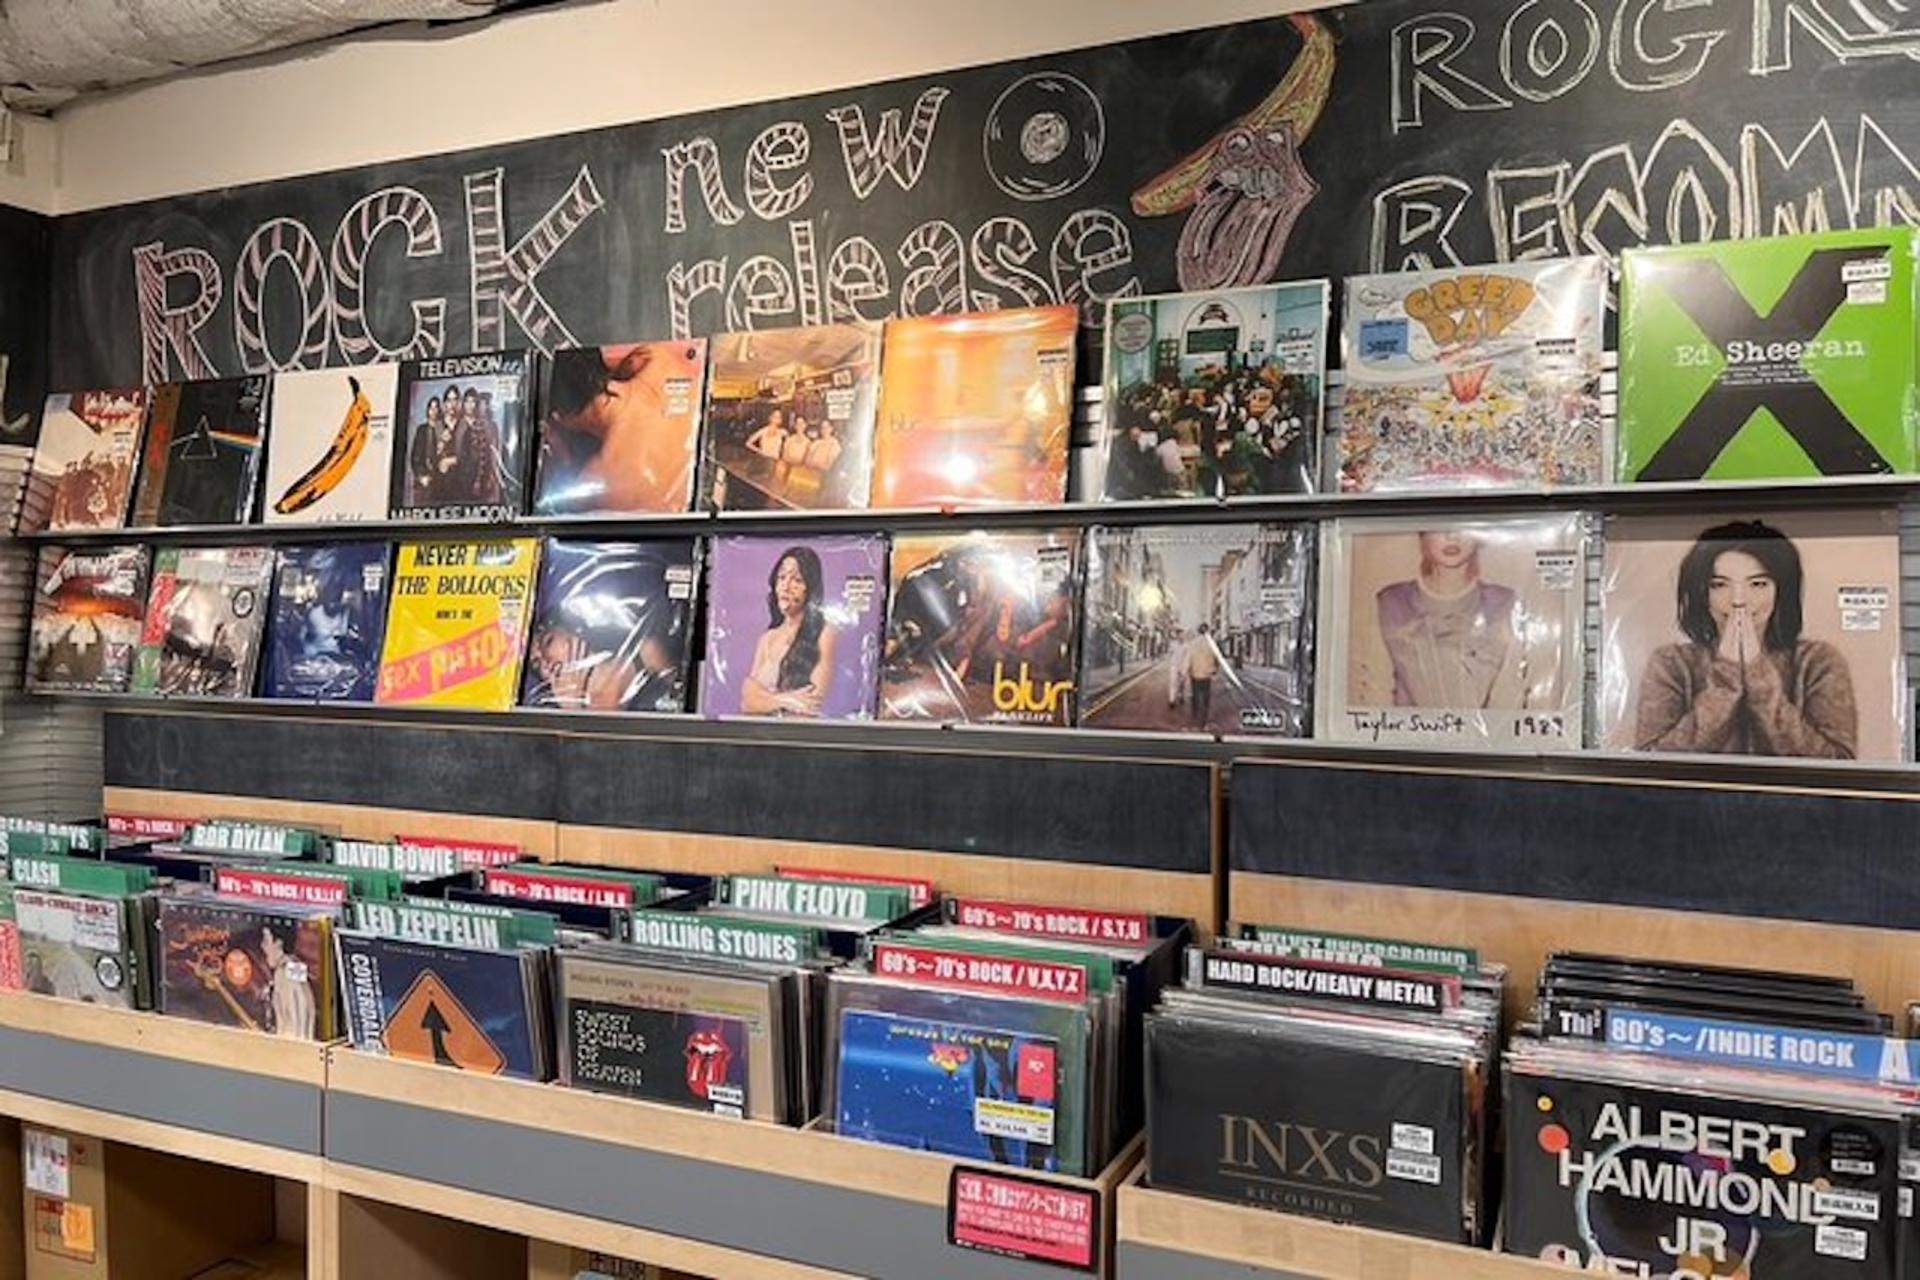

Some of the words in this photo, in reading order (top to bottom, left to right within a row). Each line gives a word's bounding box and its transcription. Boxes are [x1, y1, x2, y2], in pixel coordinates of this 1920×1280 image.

[661, 85, 950, 233] new
[133, 165, 606, 385] ROCK
[667, 208, 1143, 342] release
[1403, 274, 1538, 322] GREEN
[419, 356, 503, 379] TELEVISION
[1675, 344, 1712, 367] Ed
[1726, 338, 1866, 365] Sheeran
[414, 543, 468, 566] NEVER
[398, 575, 431, 596] THE
[436, 575, 528, 597] BOLLOCKS
[993, 661, 1074, 711] blur
[1346, 711, 1404, 742] Taylor
[1408, 713, 1465, 733] Swift
[1514, 717, 1565, 738] 1989
[13, 857, 60, 887] CLASH
[335, 841, 390, 868] DAVID
[393, 846, 455, 874] BOWIE
[734, 878, 790, 911] PINK
[794, 883, 866, 919] FLOYD
[355, 902, 396, 934] LED
[401, 907, 500, 949] ZEPPELIN
[635, 919, 715, 953] ROLLING
[718, 929, 798, 962] STONES
[1046, 911, 1089, 935] ROCK
[1325, 938, 1468, 967] UNDERGROUND
[969, 964, 1015, 986] ROCK
[1207, 958, 1255, 983] HARD
[1257, 964, 1373, 999] ROCK/HEAVY
[1375, 981, 1437, 1006] METAL
[1780, 1036, 1855, 1067] ROCK
[1878, 1037, 1911, 1085] A
[1218, 1113, 1386, 1188] INXS
[1591, 1102, 1806, 1167] ALBERT
[1558, 1148, 1838, 1226] HAMMOND
[1659, 1216, 1727, 1263] JR
